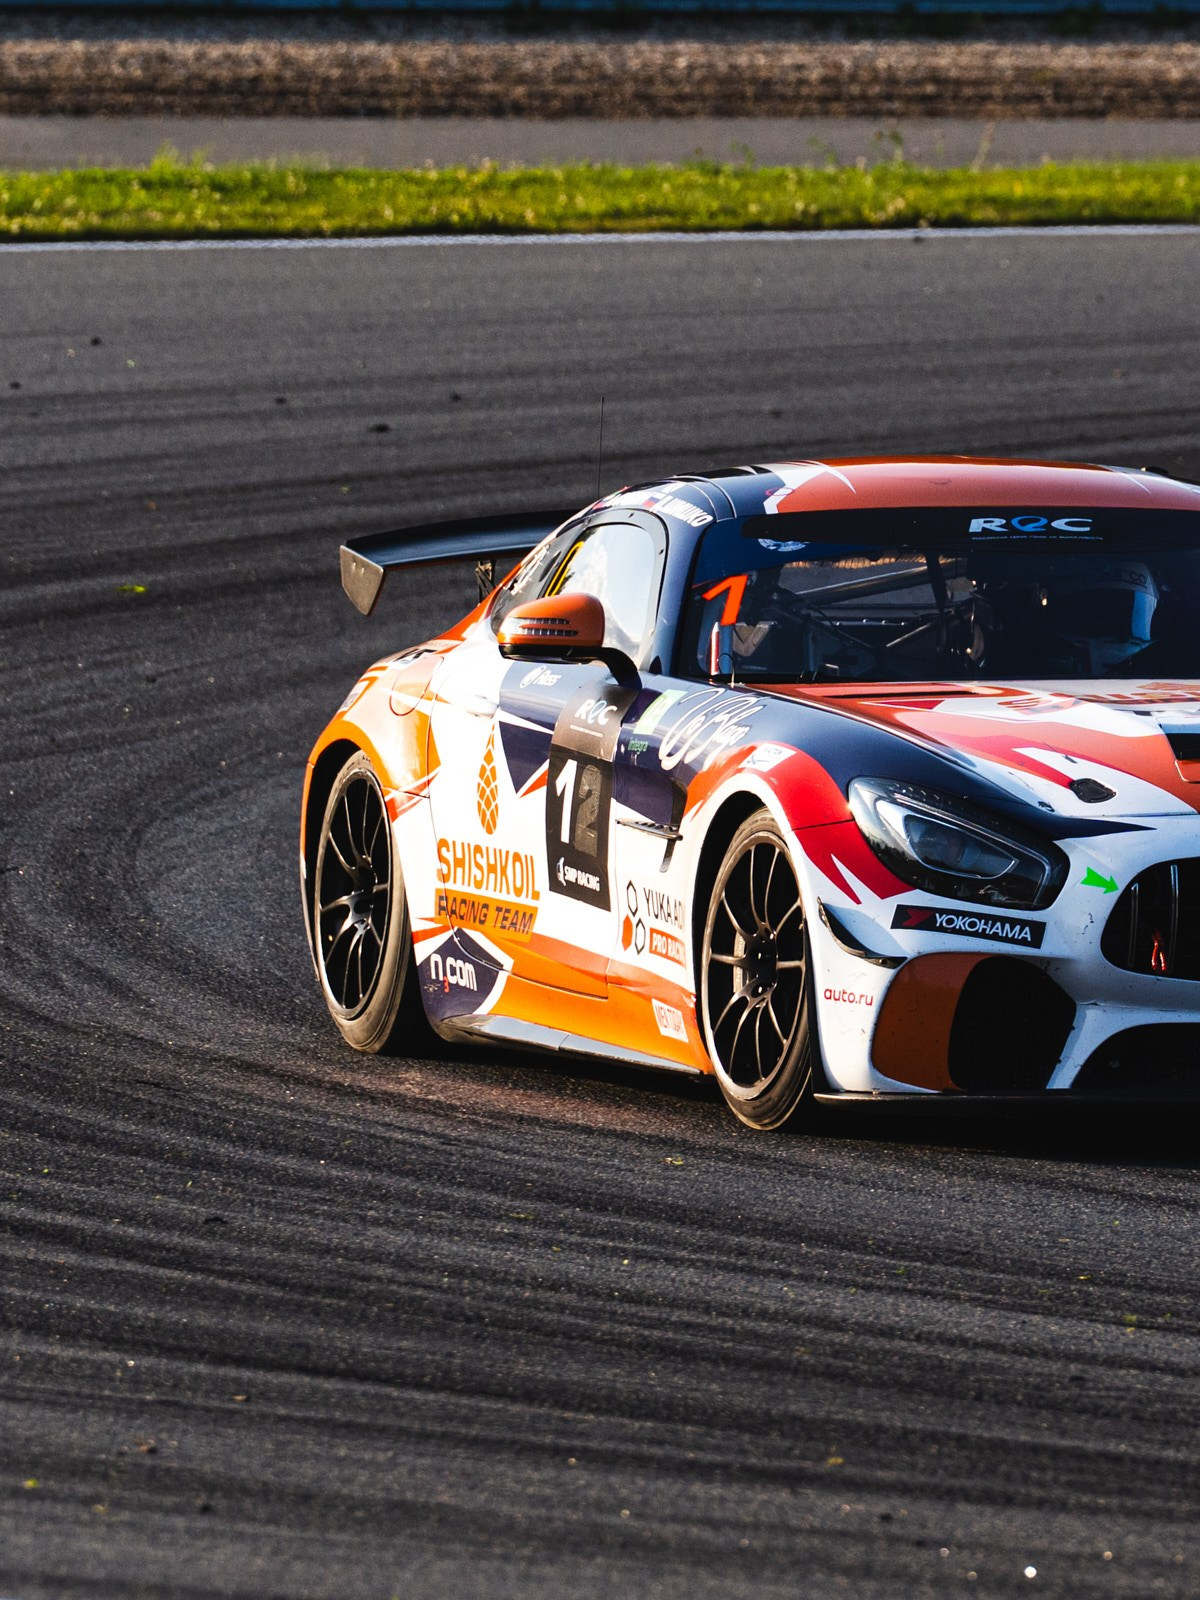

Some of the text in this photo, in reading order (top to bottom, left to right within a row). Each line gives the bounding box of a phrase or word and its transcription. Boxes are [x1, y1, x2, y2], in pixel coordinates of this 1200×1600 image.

[436, 837, 540, 901] SHISHKOIL
[578, 870, 600, 892] RACING
[437, 895, 534, 935] RACING TEAM
[935, 912, 1032, 942] YOKOHAMA
[651, 932, 668, 955] PRO
[823, 987, 874, 1006] auto.ru
